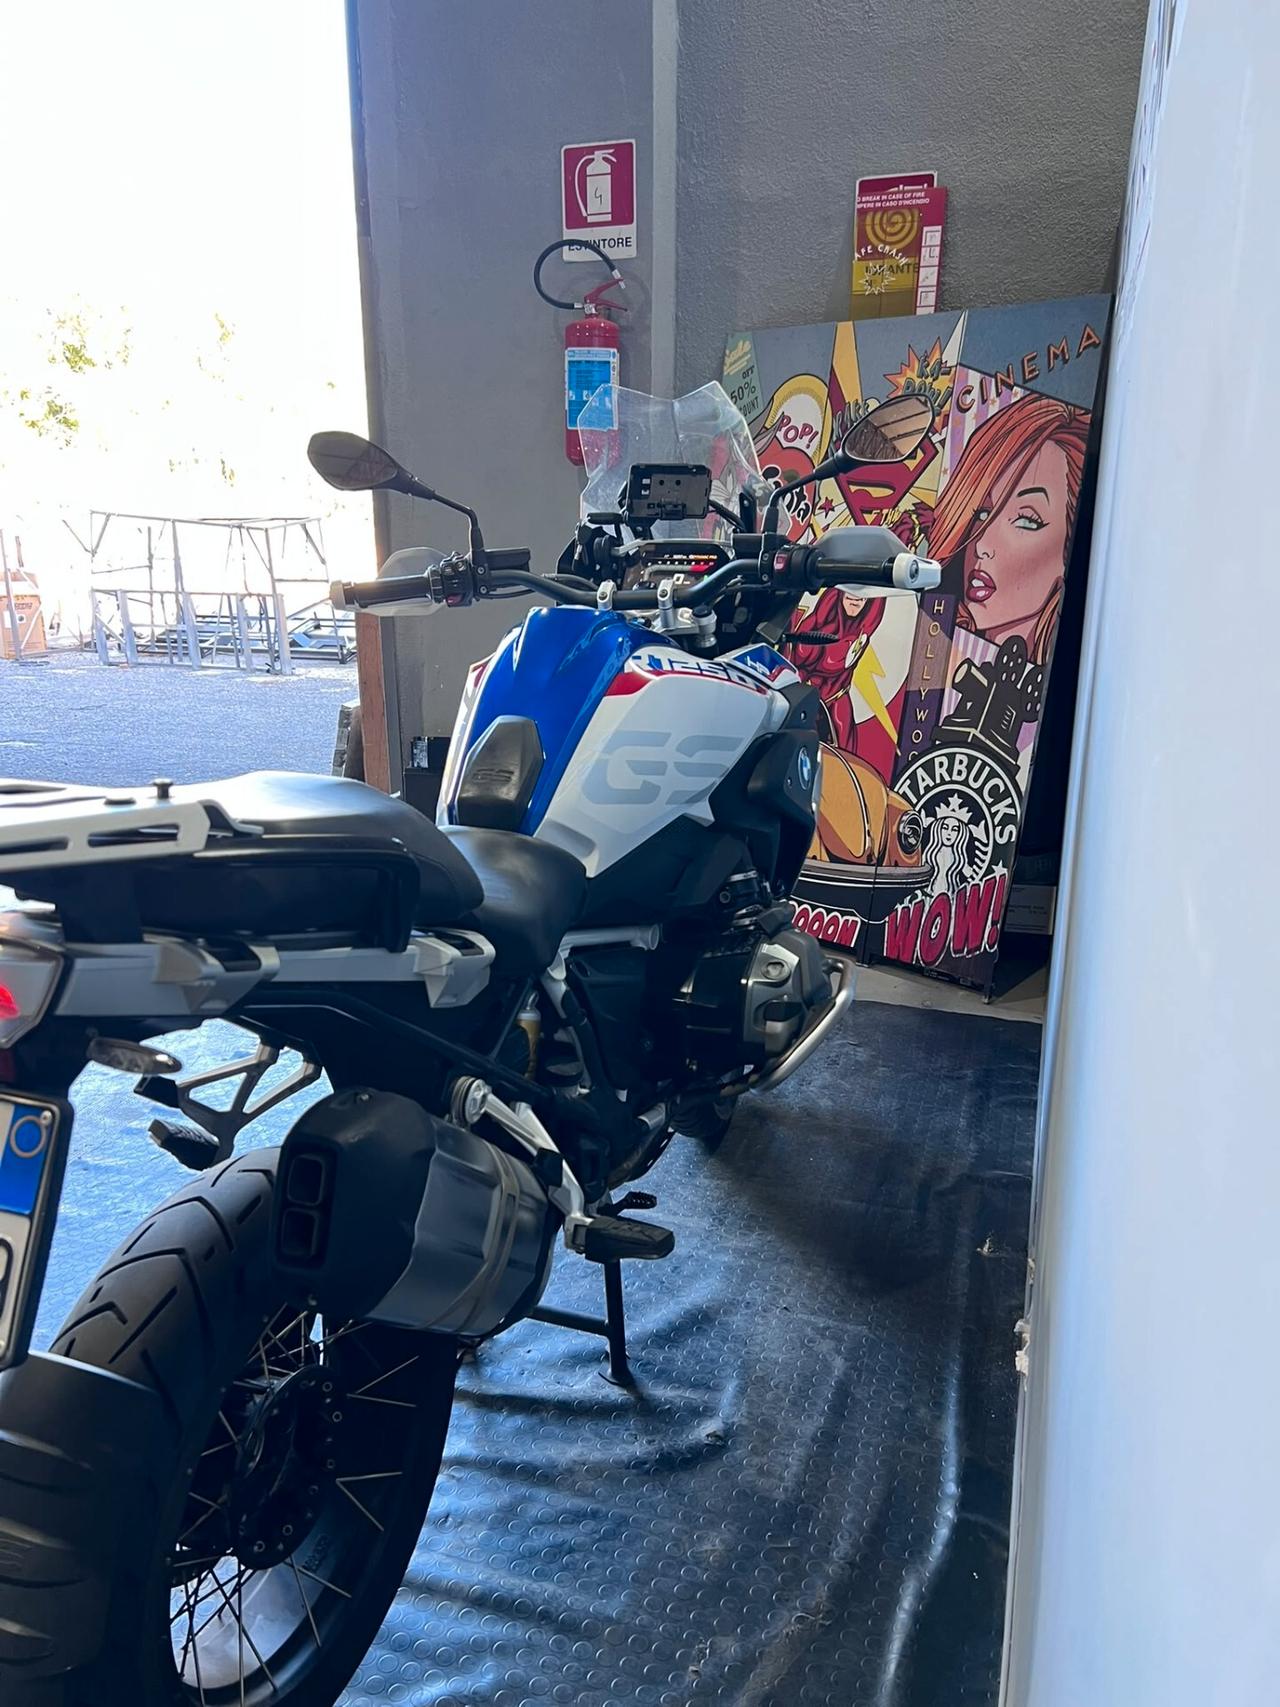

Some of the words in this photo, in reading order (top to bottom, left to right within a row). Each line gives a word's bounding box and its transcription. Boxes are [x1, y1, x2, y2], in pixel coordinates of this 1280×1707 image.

[862, 195, 881, 203] BREAK
[882, 200, 898, 208] CASO
[957, 323, 1101, 413] CINEMA
[779, 414, 819, 449] POP!
[578, 730, 747, 806] GS
[898, 753, 1017, 845] TARBUCKS
[884, 872, 1007, 967] WOW!
